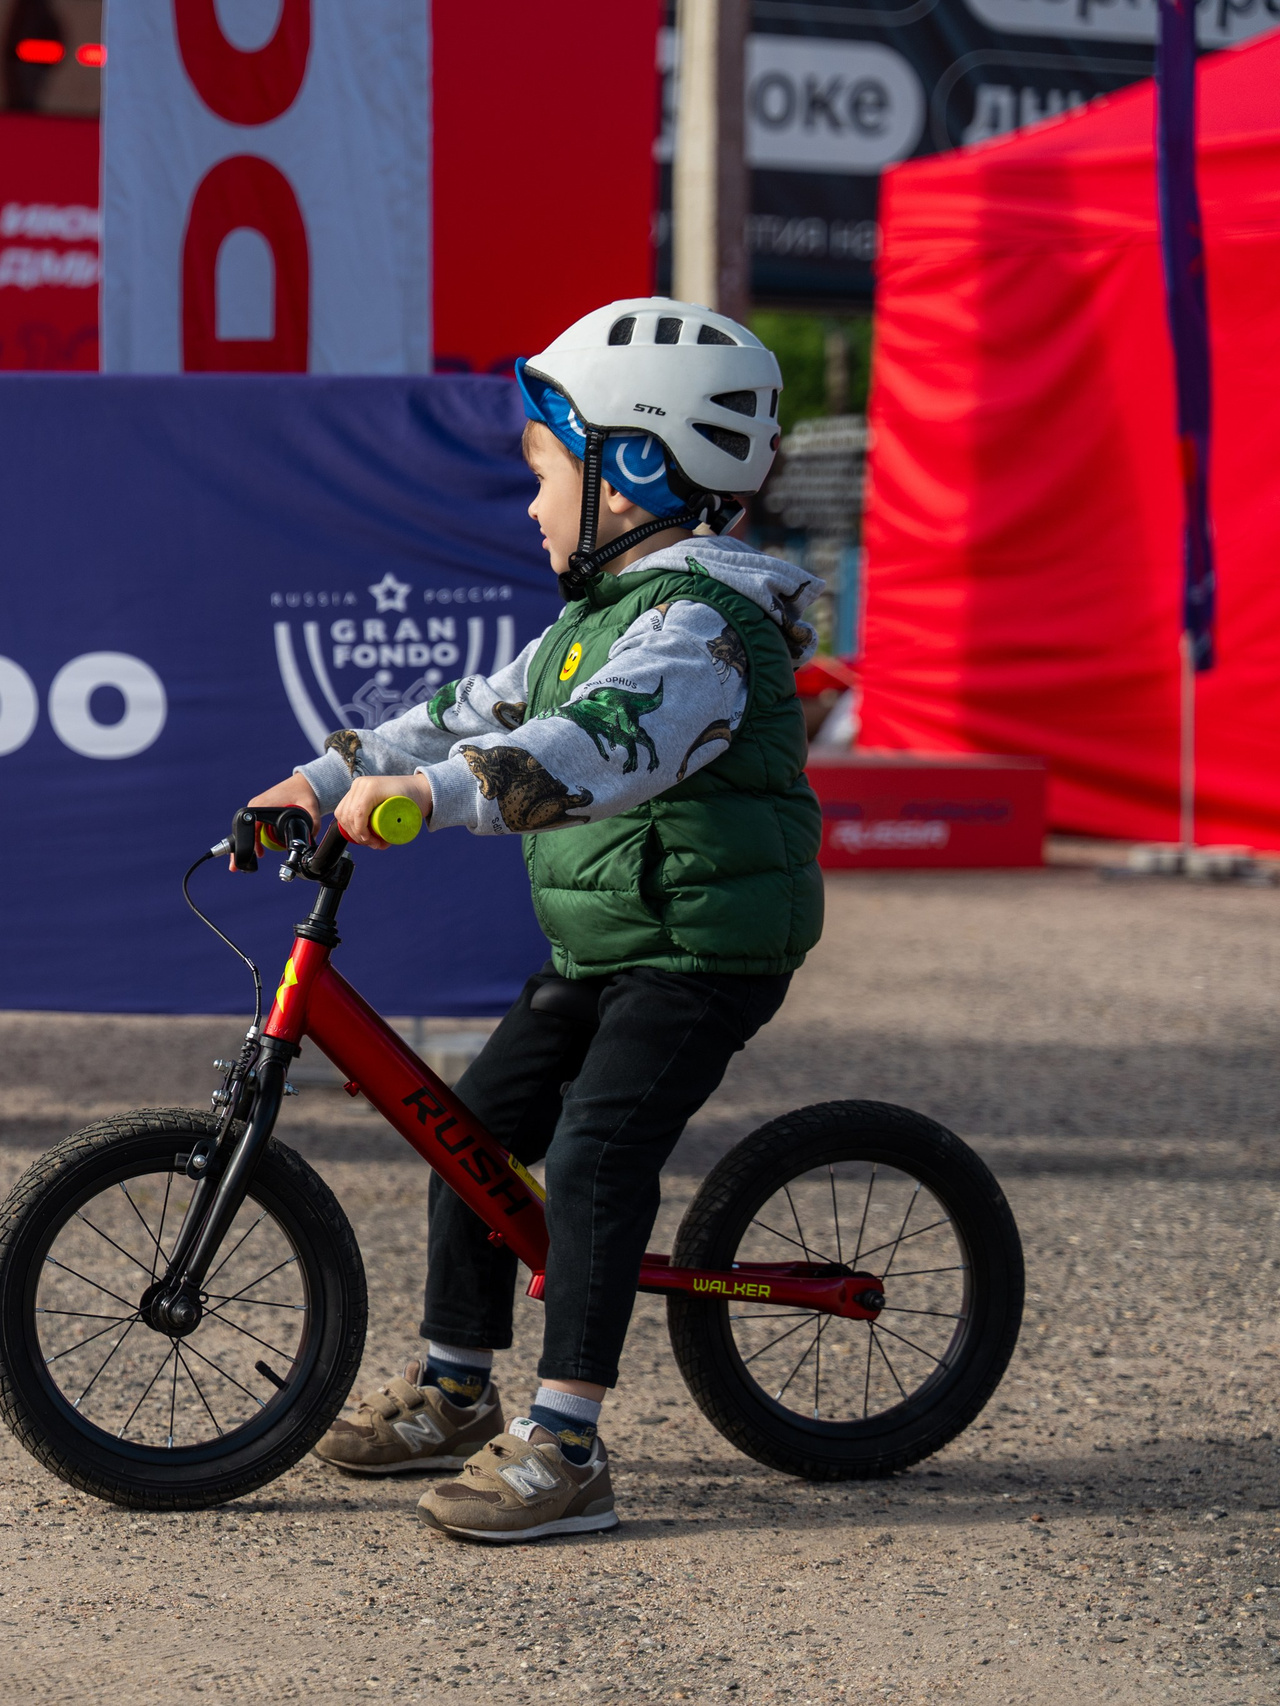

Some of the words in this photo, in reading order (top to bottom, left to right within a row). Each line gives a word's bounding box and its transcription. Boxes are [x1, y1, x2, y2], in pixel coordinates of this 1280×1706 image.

[330, 616, 457, 644] GRAN
[332, 641, 460, 669] FONDO
[401, 1086, 533, 1217] RUSH
[693, 1277, 771, 1298] WALKER
[497, 1454, 557, 1498] N
